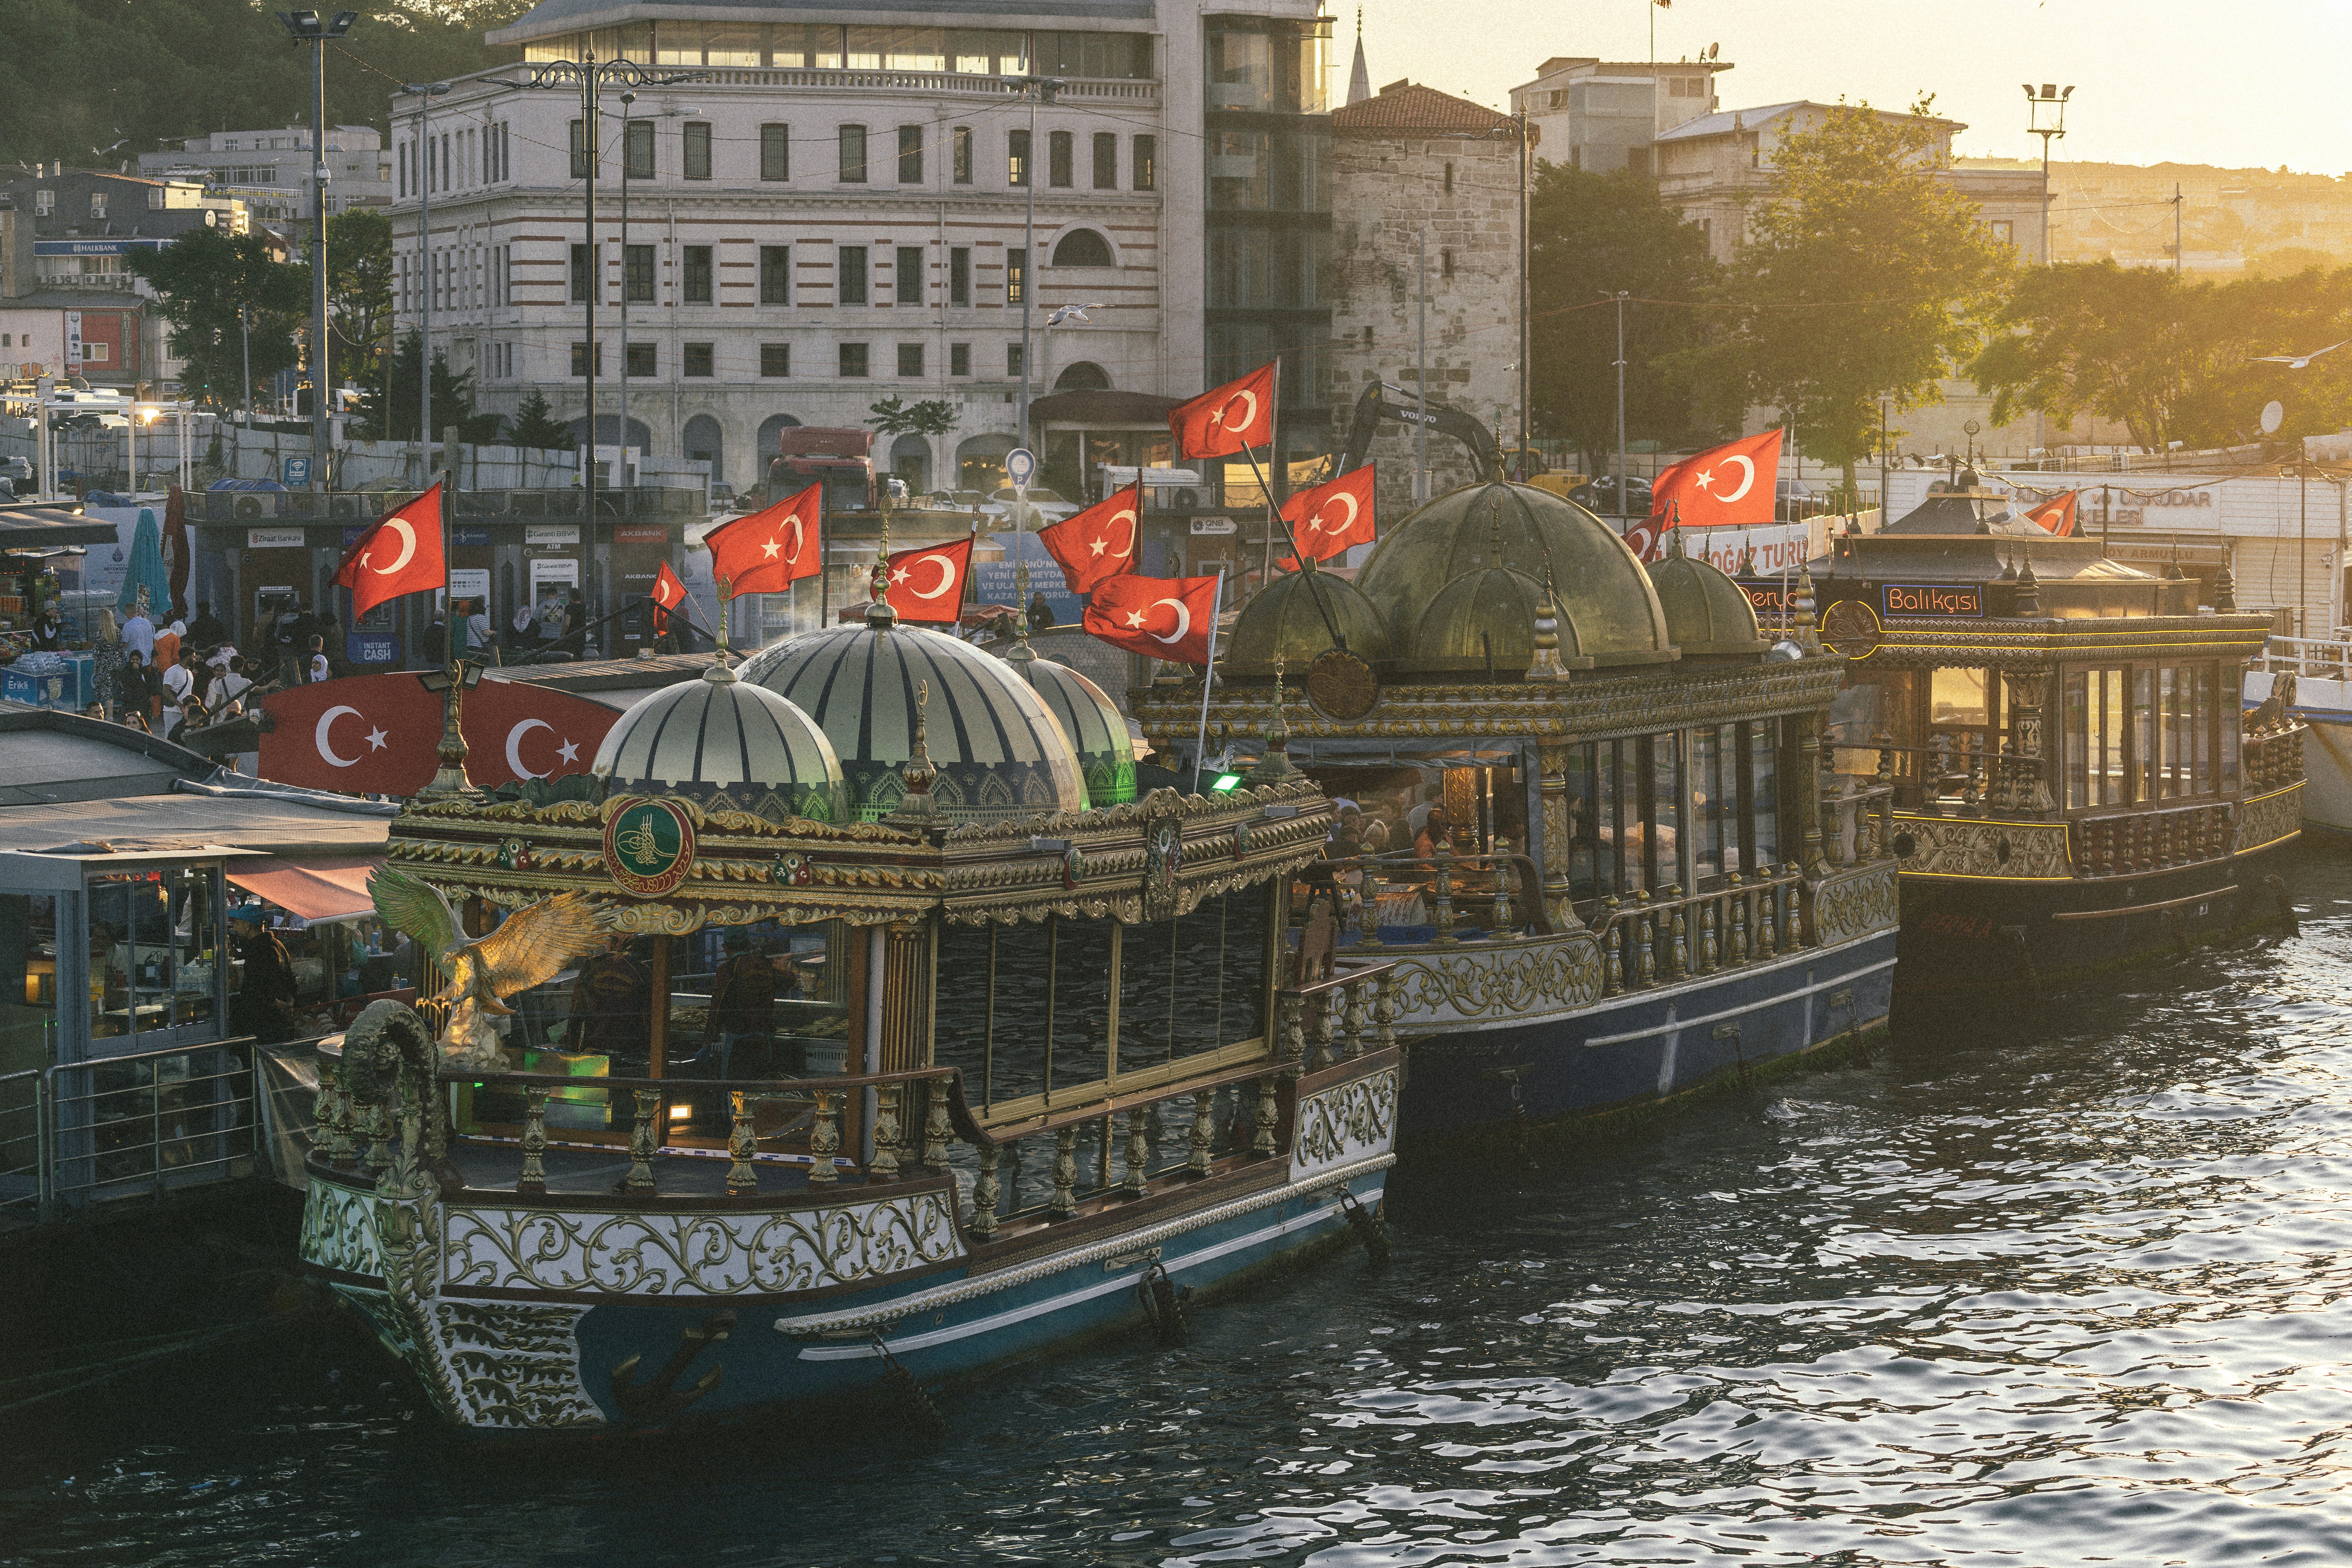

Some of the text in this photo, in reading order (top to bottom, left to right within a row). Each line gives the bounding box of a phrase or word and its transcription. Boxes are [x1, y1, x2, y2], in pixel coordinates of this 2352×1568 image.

[1698, 539, 1808, 574] OĞAZ TURU
[988, 570, 1010, 579] YENİ
[1030, 570, 1065, 579] MEYDA
[1035, 581, 1066, 589] MERKE
[1889, 588, 1977, 613] Balıkçısı
[364, 649, 391, 661] CASH
[8, 681, 29, 690] Erikli
